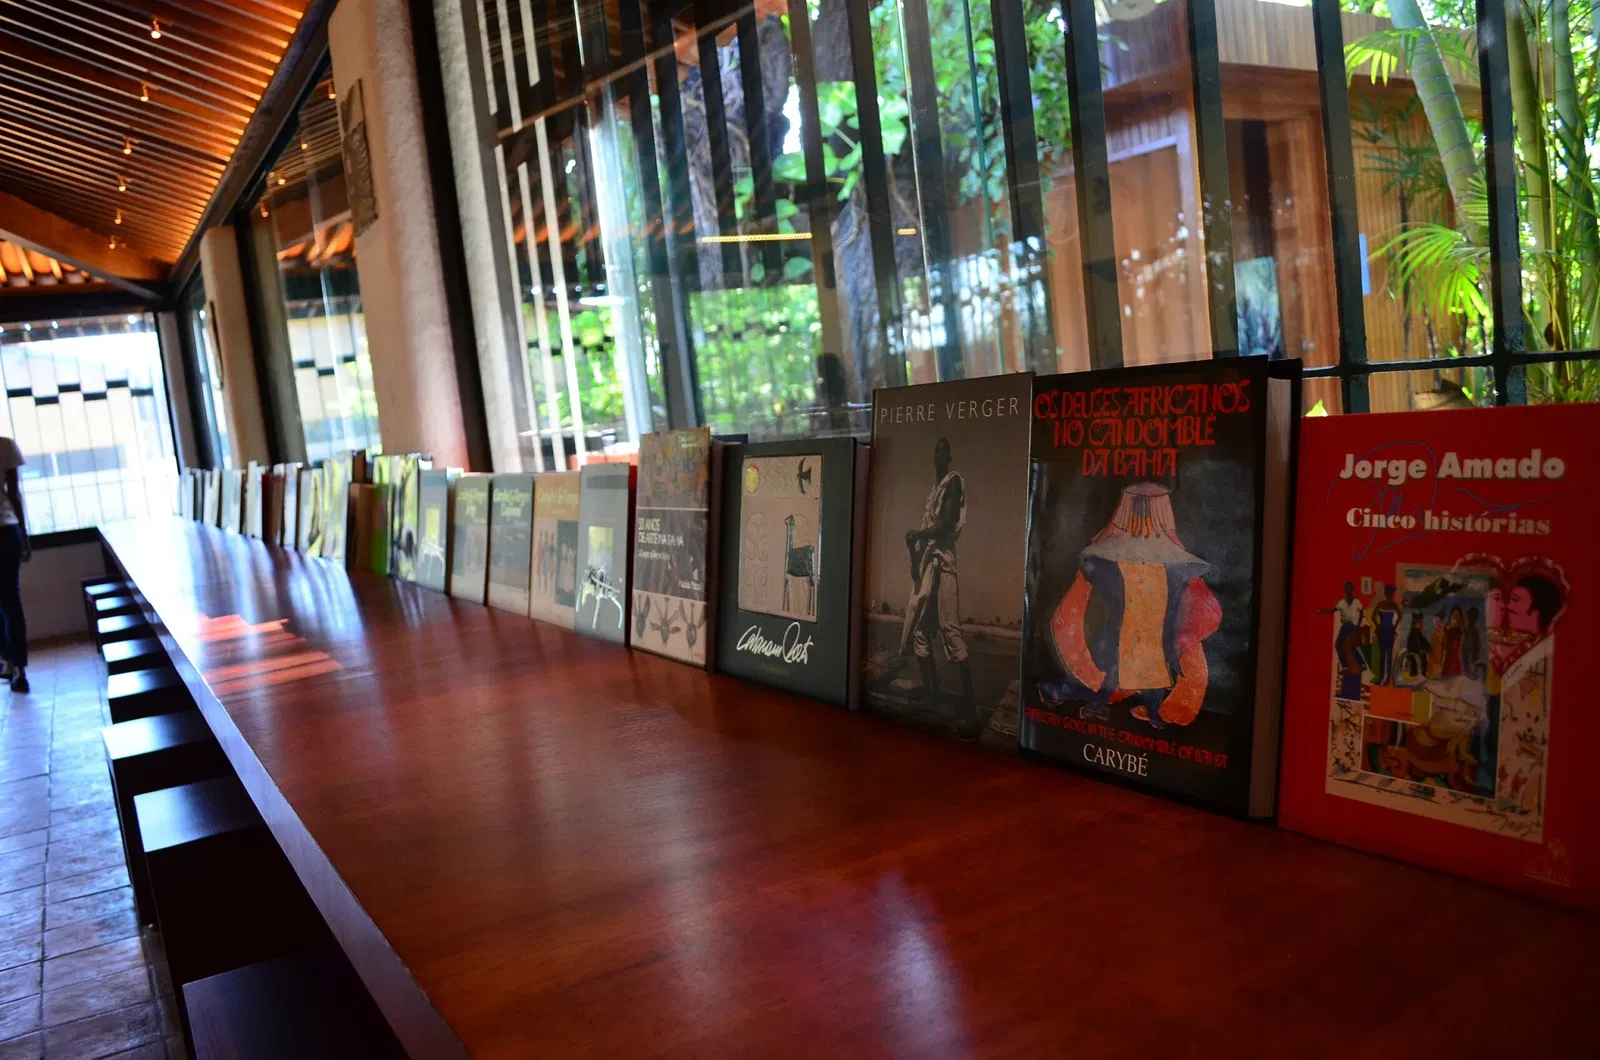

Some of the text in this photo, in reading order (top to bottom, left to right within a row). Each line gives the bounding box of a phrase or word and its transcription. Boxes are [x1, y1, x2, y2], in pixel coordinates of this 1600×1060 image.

[880, 397, 1019, 424] PIERRE VERGER
[1034, 377, 1253, 419] OS DEUSES AFRICANOS
[1053, 412, 1217, 448] NO CANDOMBLÉ
[1081, 447, 1180, 478] DA BAHIA
[1339, 448, 1566, 486] Jorge Amado
[1346, 508, 1550, 535] Cinco histórias
[1082, 743, 1149, 777] CARYBÉ
